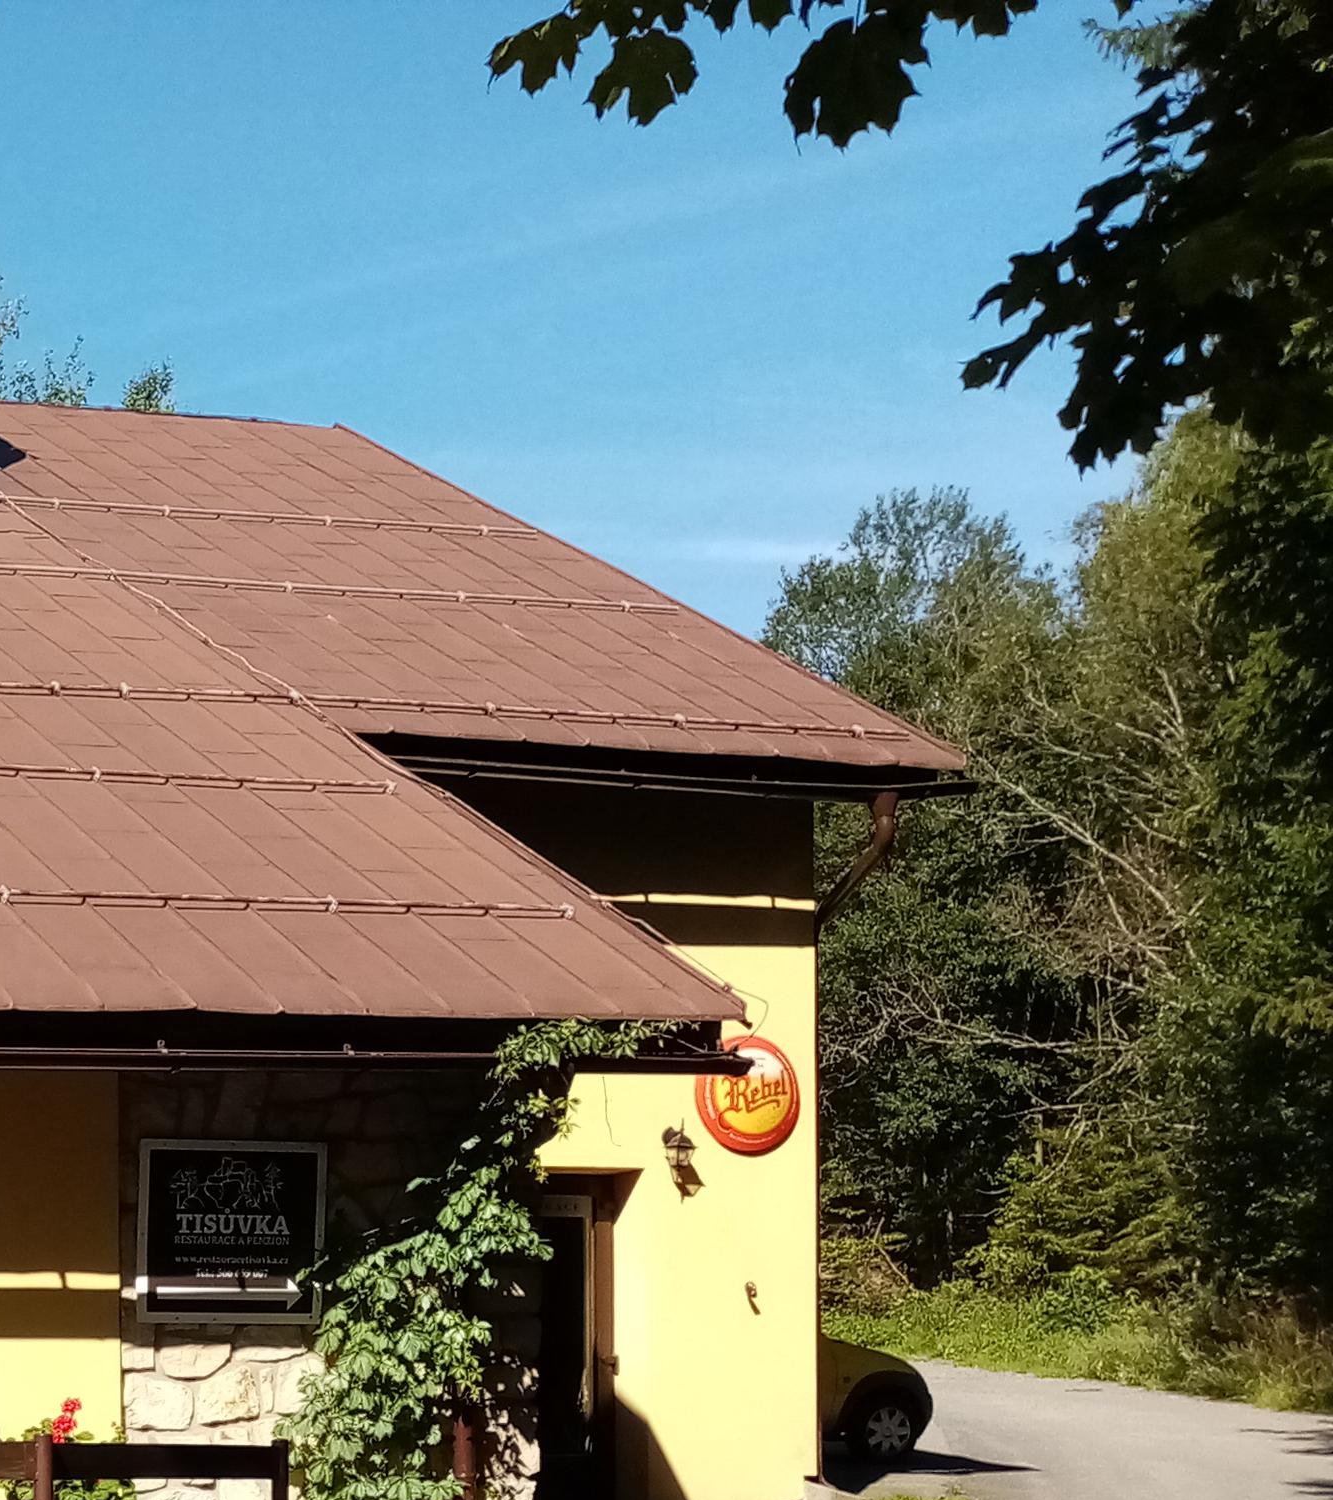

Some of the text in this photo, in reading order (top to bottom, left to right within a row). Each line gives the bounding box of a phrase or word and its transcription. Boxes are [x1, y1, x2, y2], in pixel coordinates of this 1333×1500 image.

[720, 1070, 788, 1113] Rebel
[176, 1208, 290, 1235] TISŮVKA
[174, 1236, 290, 1246] RESTAURACE A PENZION
